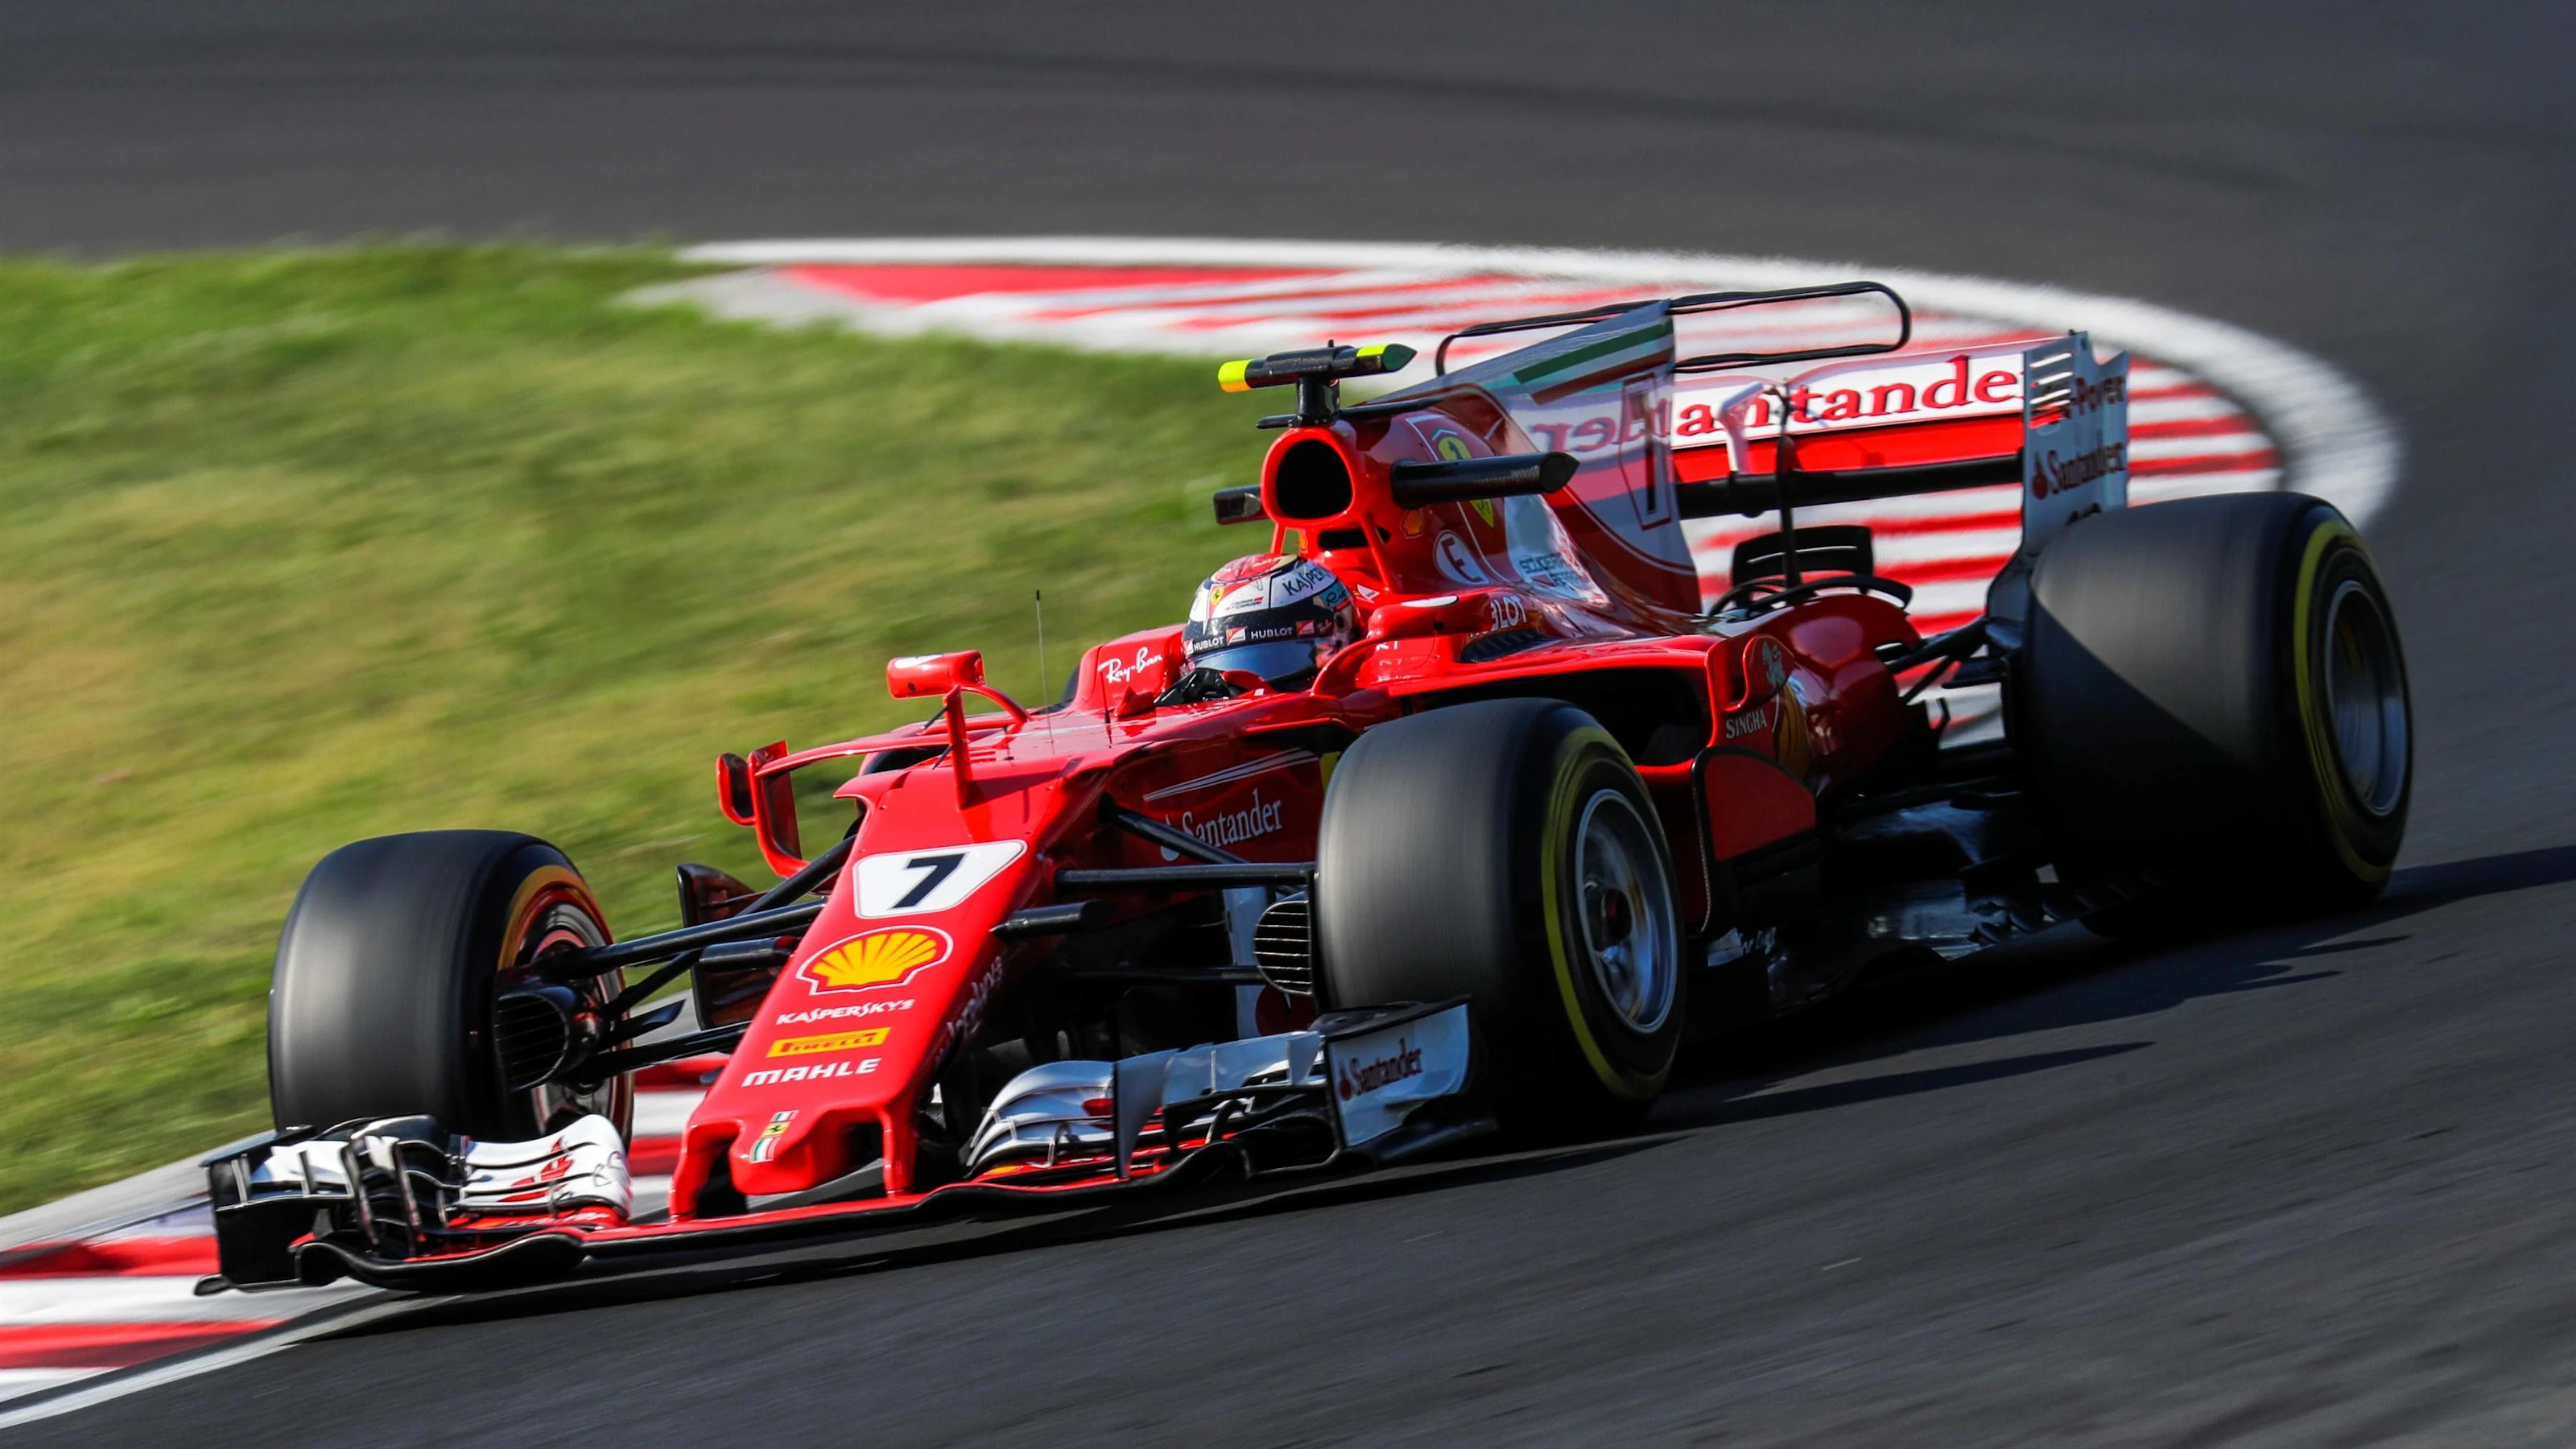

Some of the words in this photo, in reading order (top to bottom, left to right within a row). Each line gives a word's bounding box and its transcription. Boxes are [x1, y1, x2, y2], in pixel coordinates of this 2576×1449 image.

[1677, 354, 2024, 437] antande
[2047, 428, 2126, 495] Santander
[1194, 636, 1224, 651] HUBLOT
[1251, 627, 1293, 640] HUBLOT
[1097, 647, 1163, 683] Ray-Ban
[1182, 788, 1283, 848] Santander
[891, 853, 965, 910] 7
[775, 999, 905, 1026] KASPERSKY
[780, 1032, 878, 1053] PIRELLI
[741, 1058, 882, 1087] MAHLE
[1349, 1038, 1422, 1096] Santander
